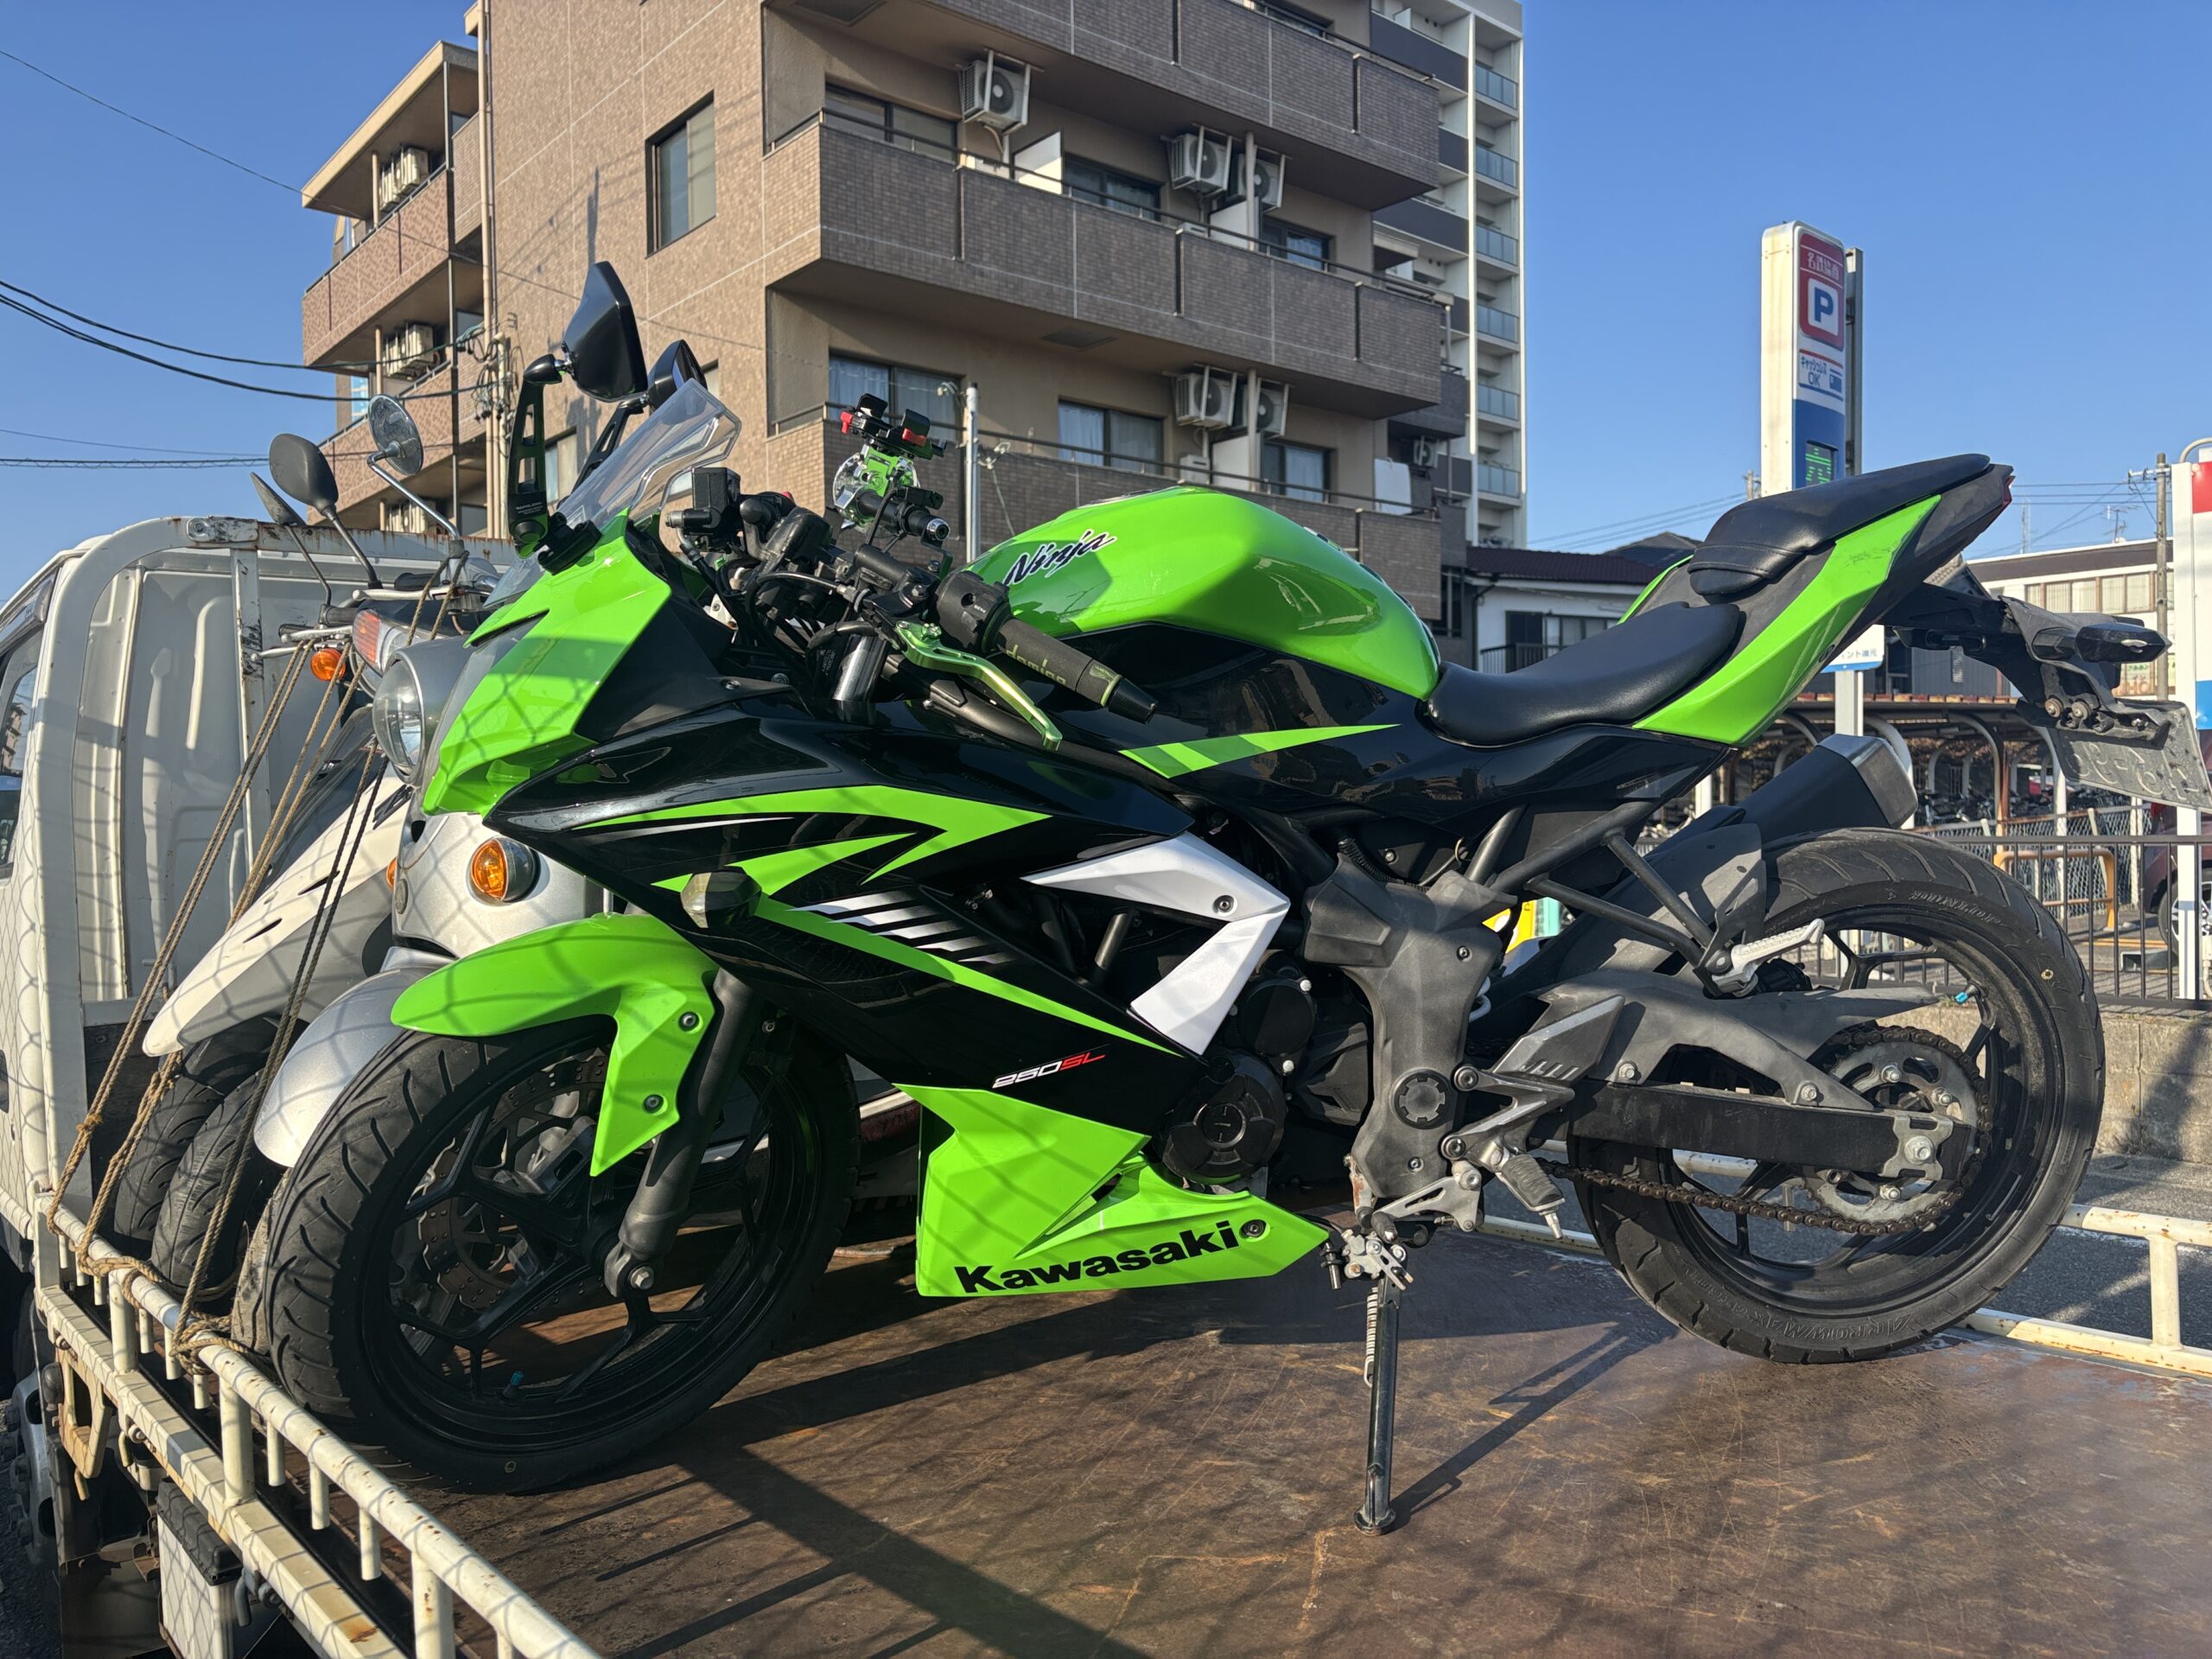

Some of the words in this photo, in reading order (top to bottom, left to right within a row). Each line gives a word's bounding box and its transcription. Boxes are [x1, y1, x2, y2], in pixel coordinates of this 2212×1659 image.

[1814, 287, 1834, 323] P
[1808, 372, 1821, 388] OK
[1002, 529, 1117, 586] Ninja
[991, 1052, 1107, 1090] 250SL
[953, 1219, 1241, 1294] Kawasaki
